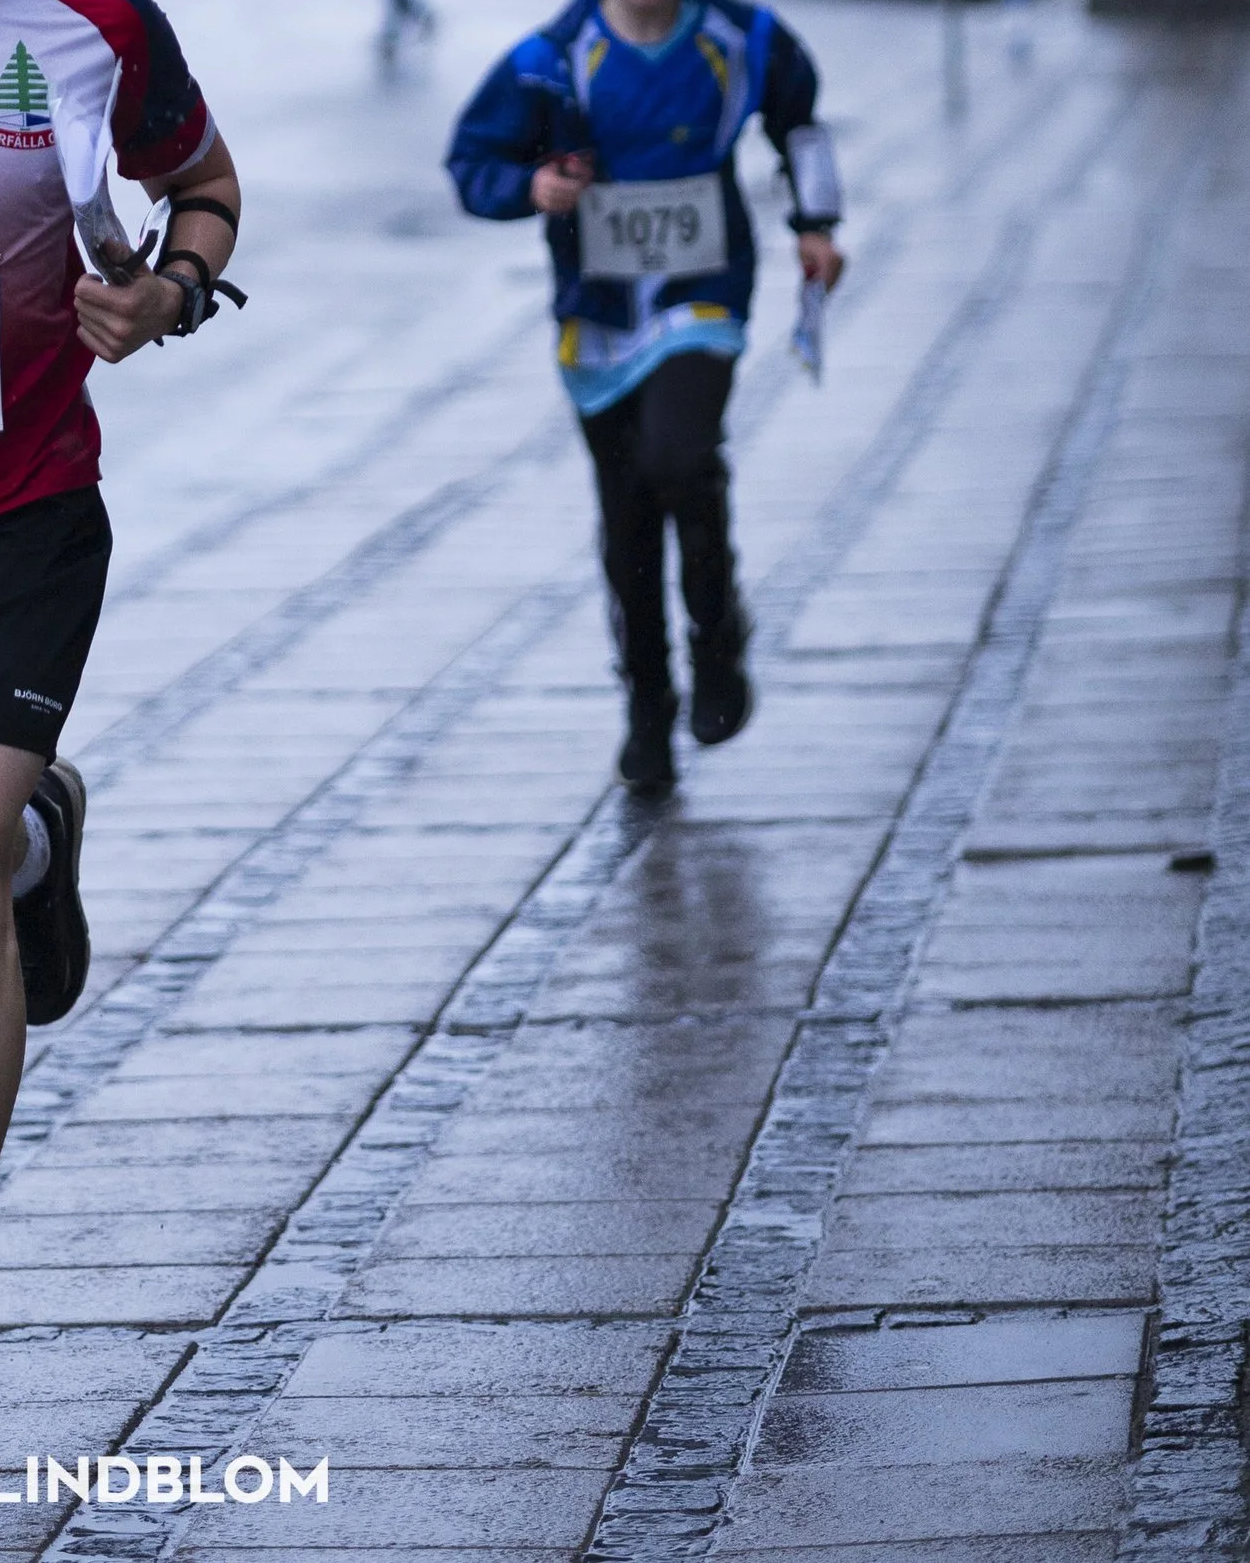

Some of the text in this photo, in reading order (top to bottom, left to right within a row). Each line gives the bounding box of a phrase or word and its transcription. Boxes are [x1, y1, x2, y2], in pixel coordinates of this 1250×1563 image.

[605, 203, 701, 246] 1079
[14, 688, 44, 703] BJÖRN
[45, 697, 62, 711] BORG
